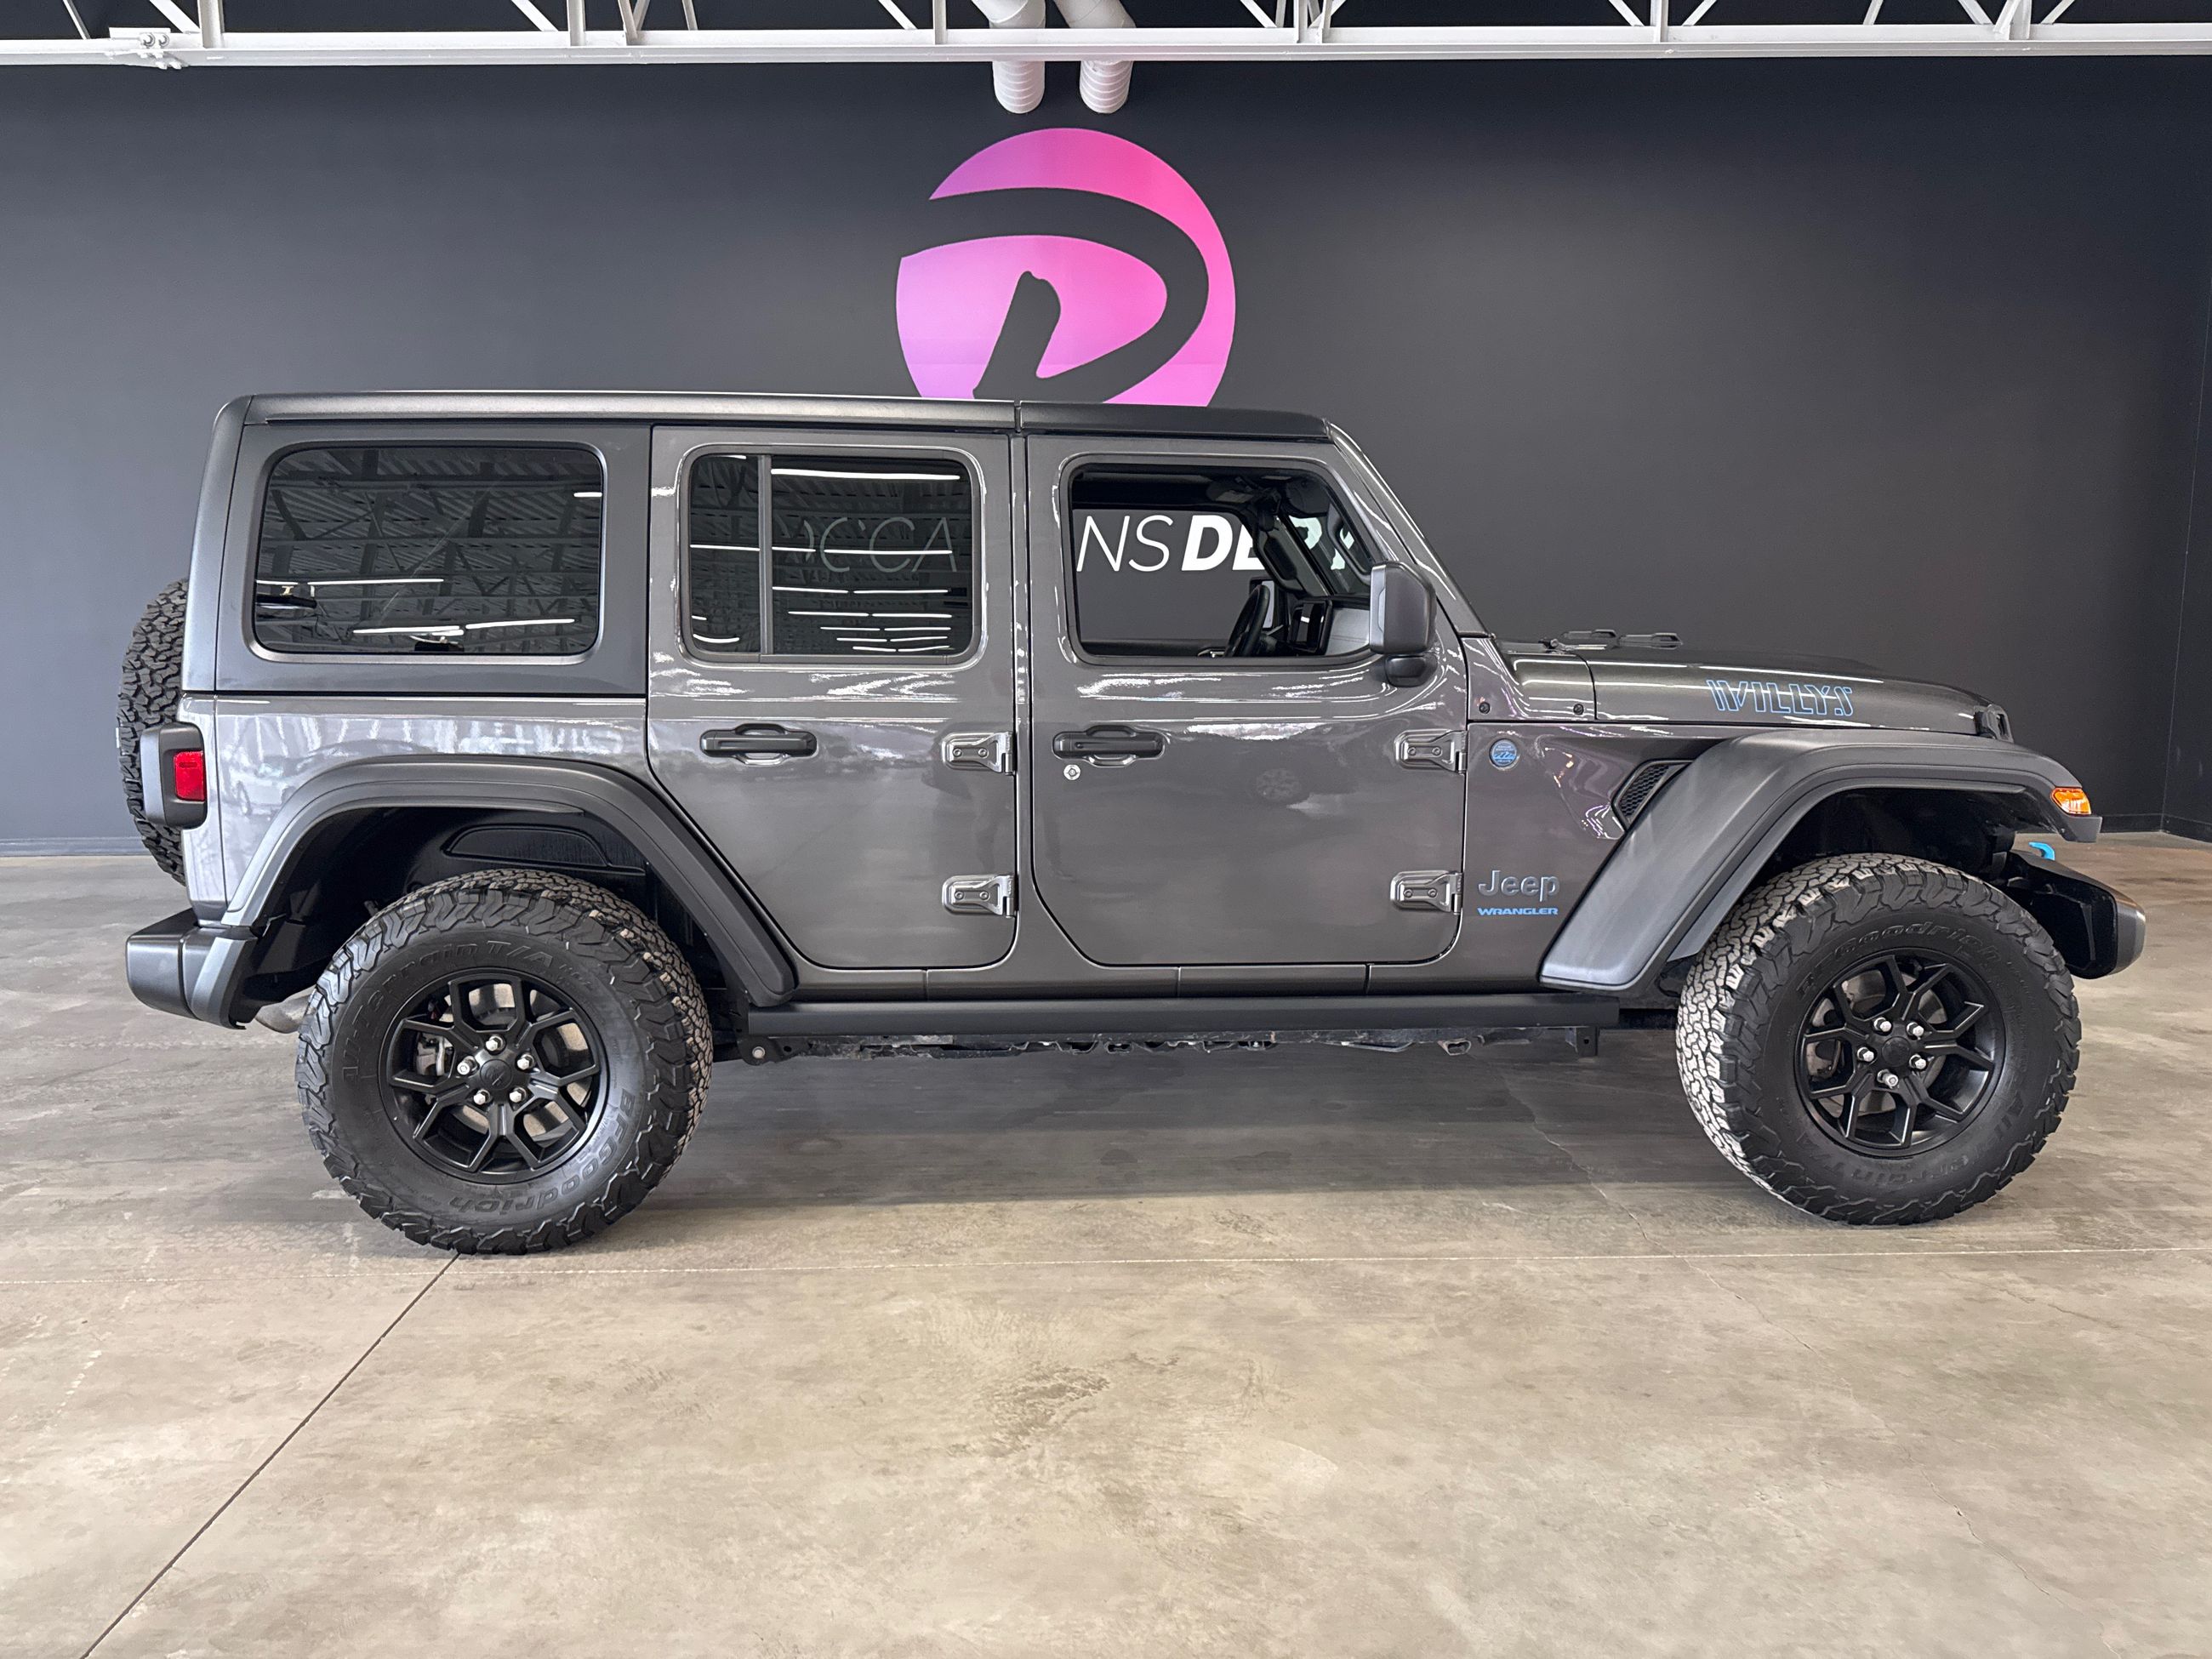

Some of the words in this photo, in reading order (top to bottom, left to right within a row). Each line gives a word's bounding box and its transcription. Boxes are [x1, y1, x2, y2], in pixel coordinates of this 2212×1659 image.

[1706, 679, 1854, 716] WILLYS
[1478, 869, 1560, 903] Jeep
[1477, 907, 1559, 915] WRANGLER
